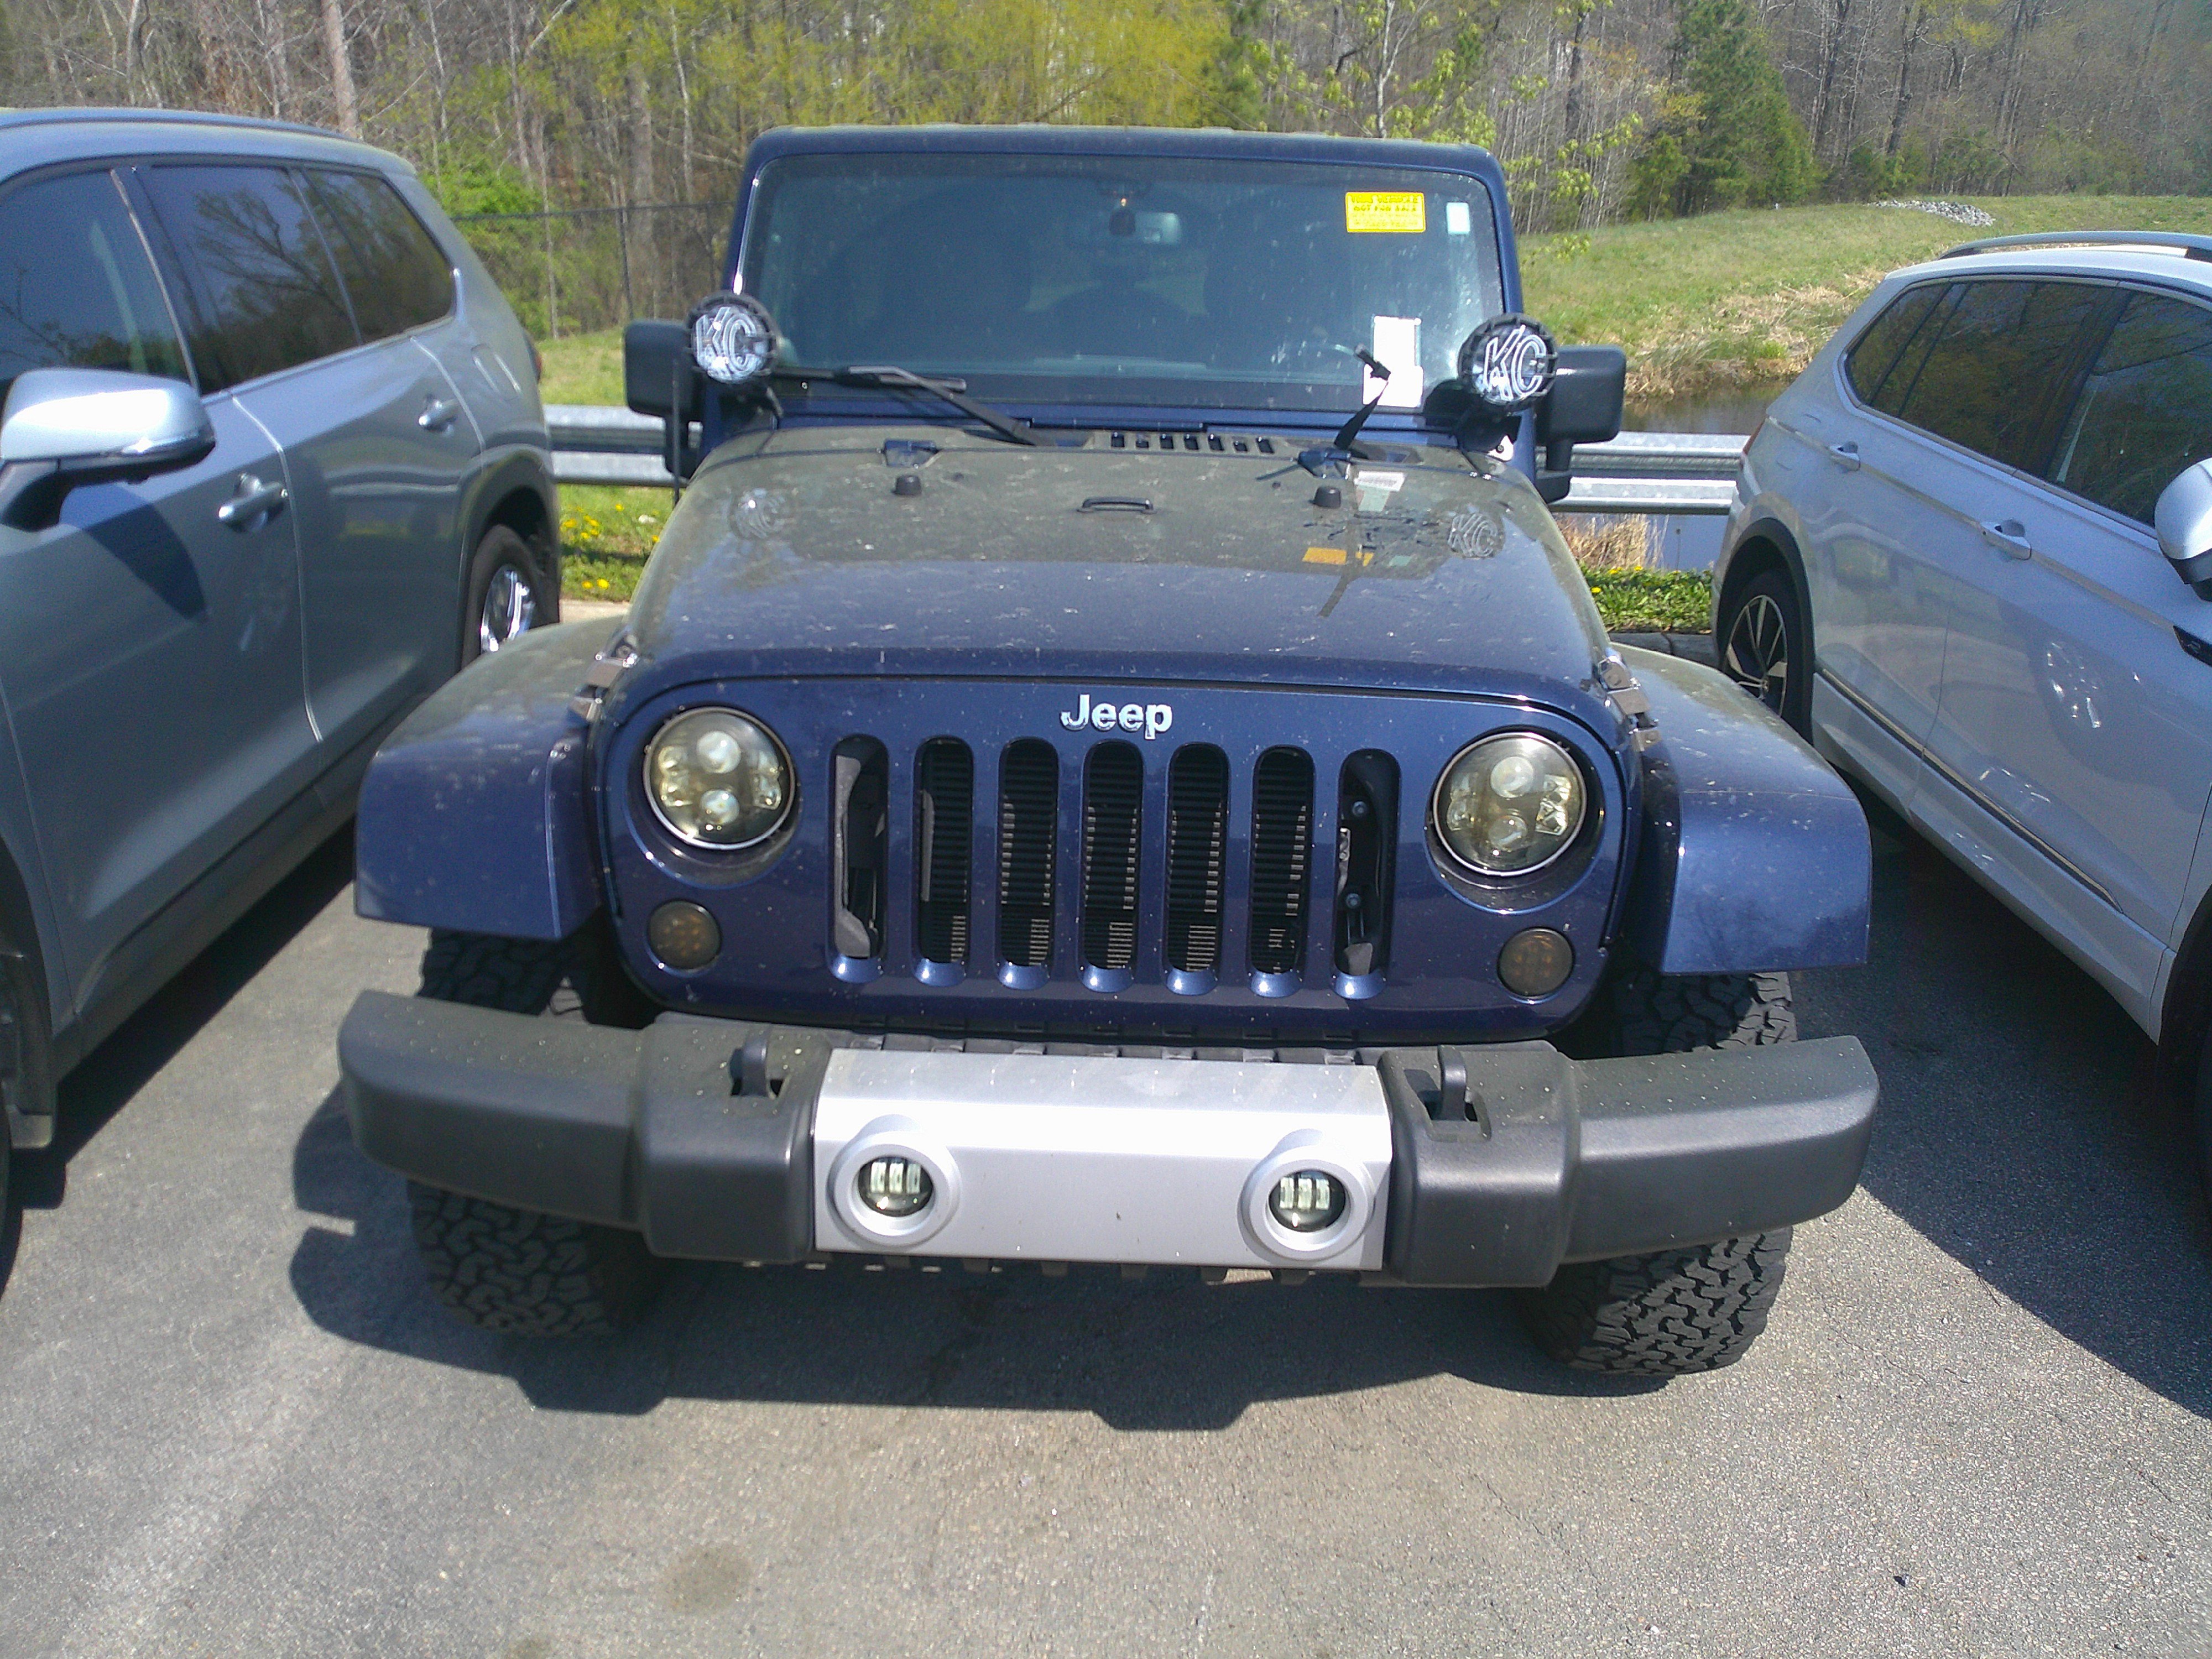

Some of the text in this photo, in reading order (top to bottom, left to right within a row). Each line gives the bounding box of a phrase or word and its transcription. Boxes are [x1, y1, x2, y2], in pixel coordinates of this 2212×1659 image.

[696, 306, 757, 380] KC
[1483, 325, 1547, 401] KC
[1060, 693, 1172, 740] Jeep
